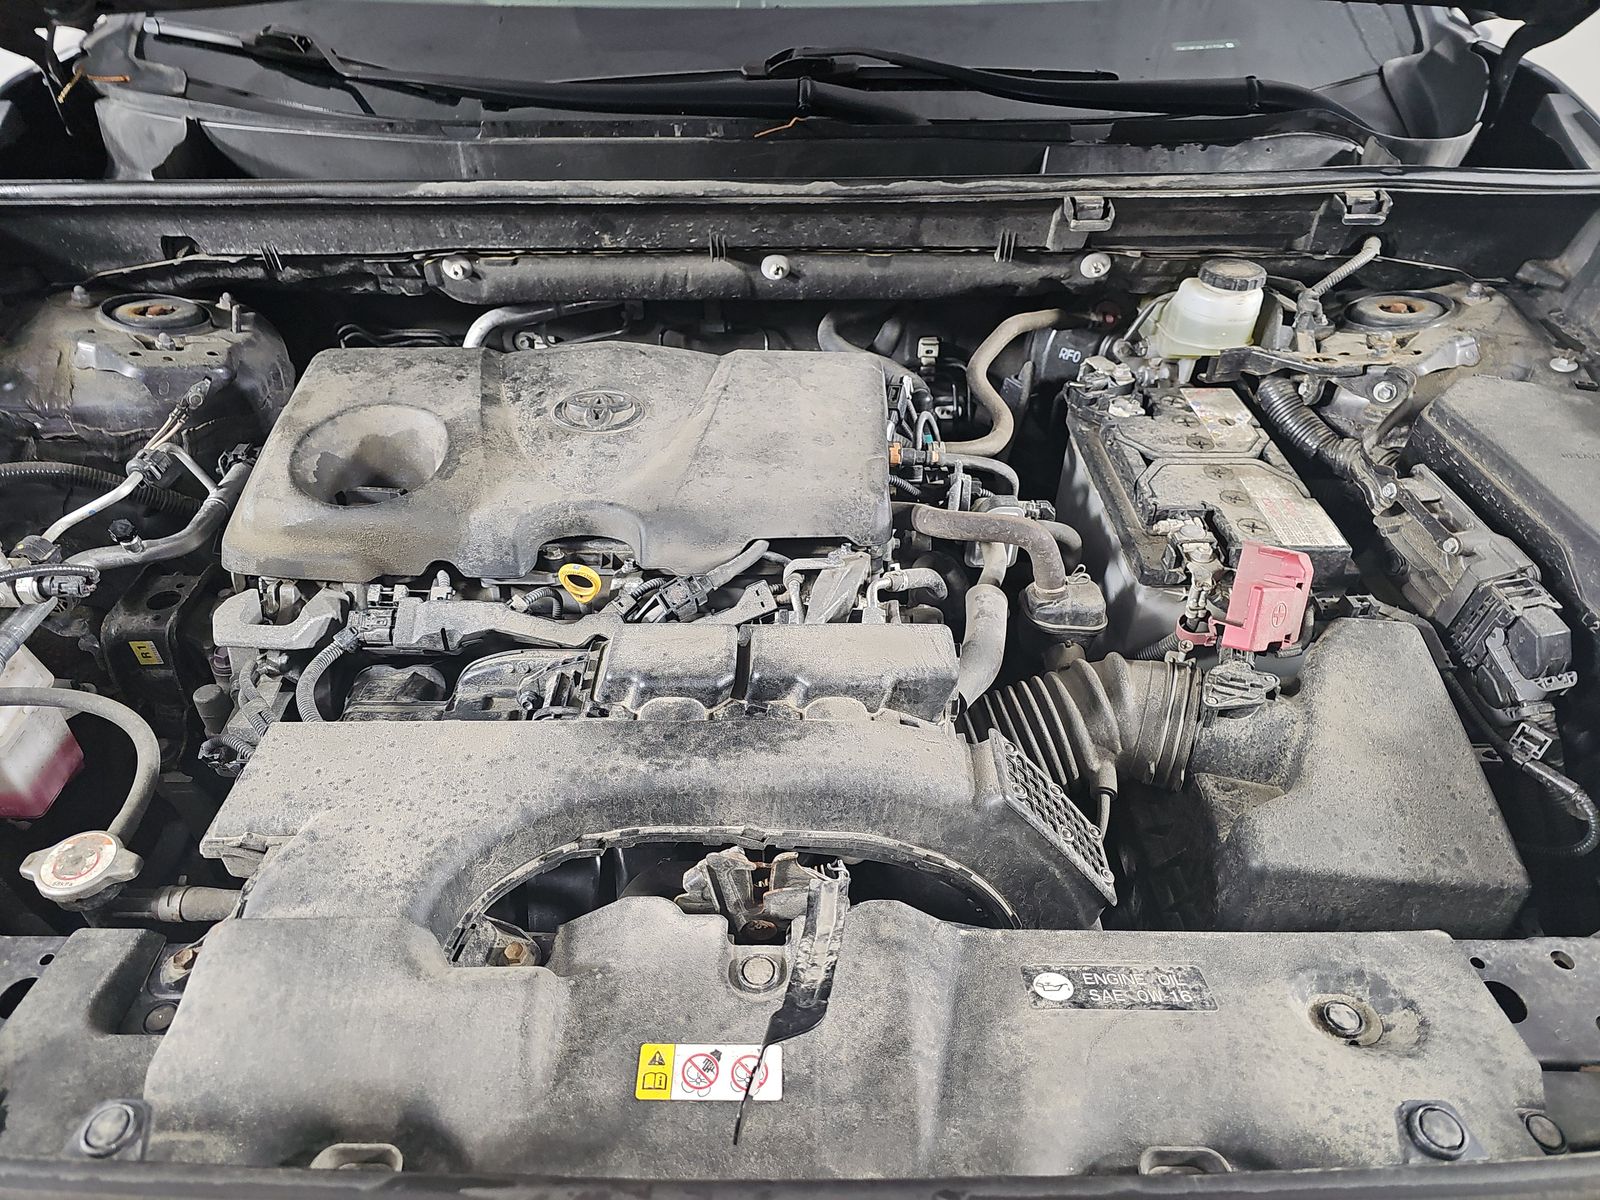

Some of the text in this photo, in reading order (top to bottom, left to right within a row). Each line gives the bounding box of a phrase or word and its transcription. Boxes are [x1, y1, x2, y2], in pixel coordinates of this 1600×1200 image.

[1082, 972, 1188, 986] ENGINE OIL
[1089, 989, 1193, 1002] SAE 0W-16
